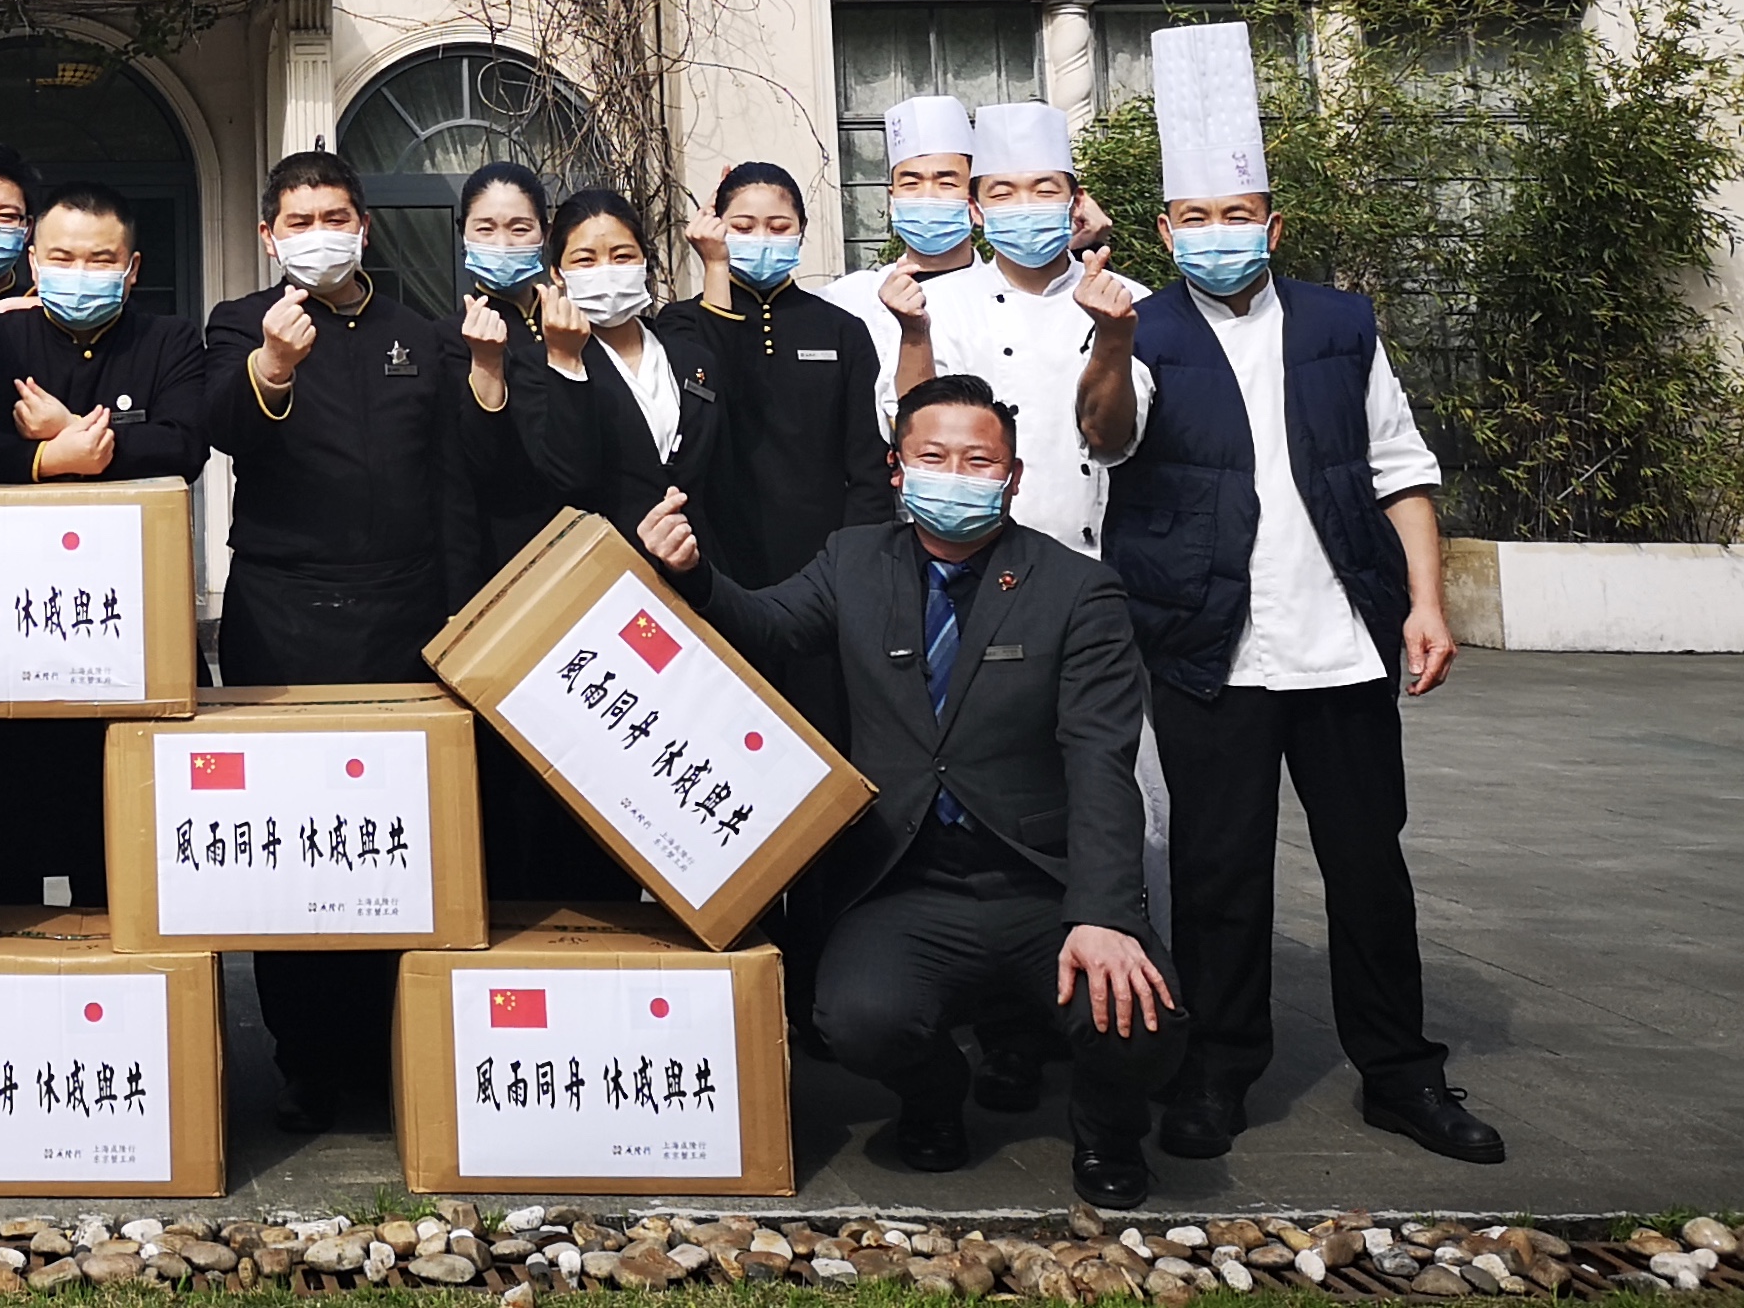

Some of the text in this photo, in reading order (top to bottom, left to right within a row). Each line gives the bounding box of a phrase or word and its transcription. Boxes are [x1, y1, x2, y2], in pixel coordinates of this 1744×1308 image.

[556, 649, 660, 751] 風雨同舟
[176, 816, 281, 871] 風雨同舟
[476, 1056, 585, 1112] 風雨同舟
